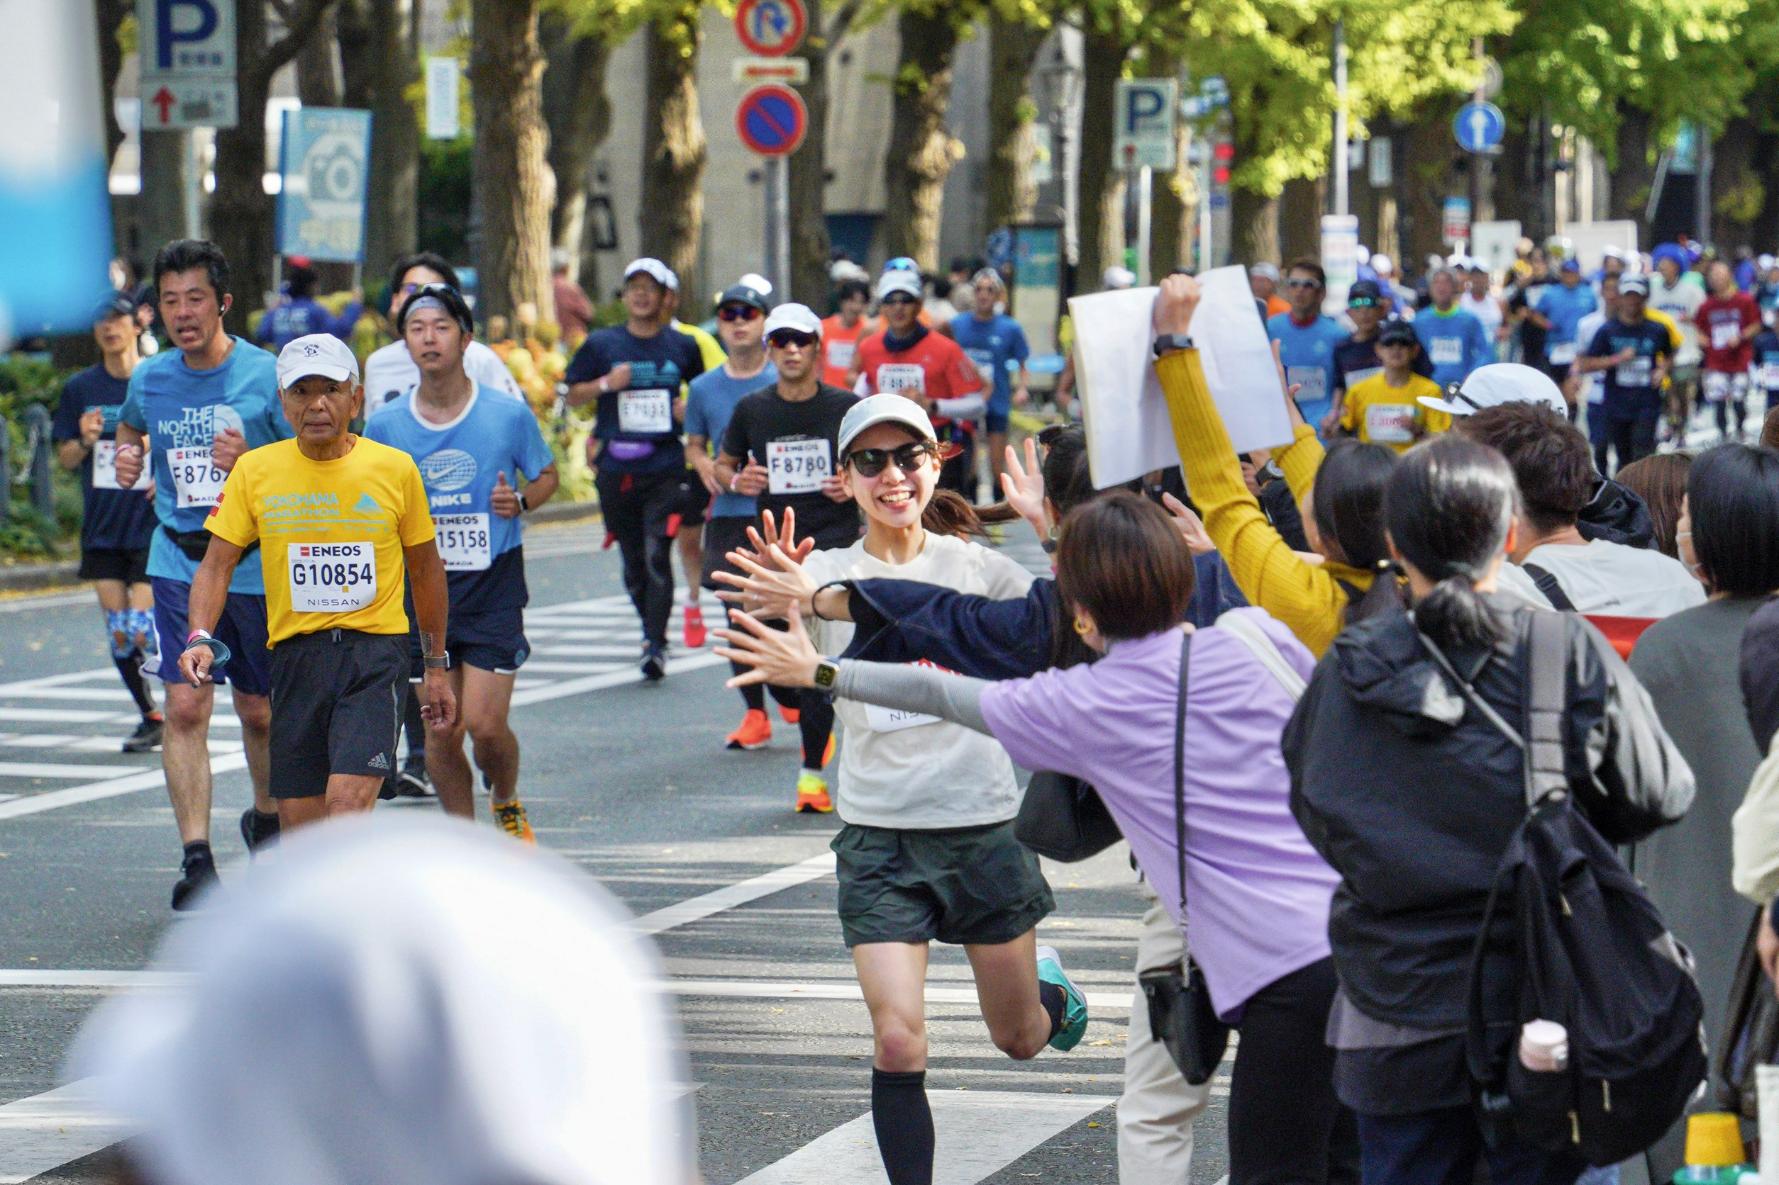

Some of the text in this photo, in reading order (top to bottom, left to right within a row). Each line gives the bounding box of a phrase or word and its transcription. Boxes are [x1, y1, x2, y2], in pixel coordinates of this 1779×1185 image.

[156, 0, 218, 68] P
[1127, 88, 1164, 133] P
[182, 405, 214, 424] THE
[158, 418, 213, 435] NORTH
[173, 433, 213, 448] FACE
[185, 448, 215, 459] ENEO
[771, 455, 827, 473] F8780
[431, 493, 472, 507] NIKE
[439, 516, 479, 525] ENEOS
[312, 545, 362, 557] ENEOS
[293, 563, 373, 587] G10854
[307, 598, 361, 607] NISSAN
